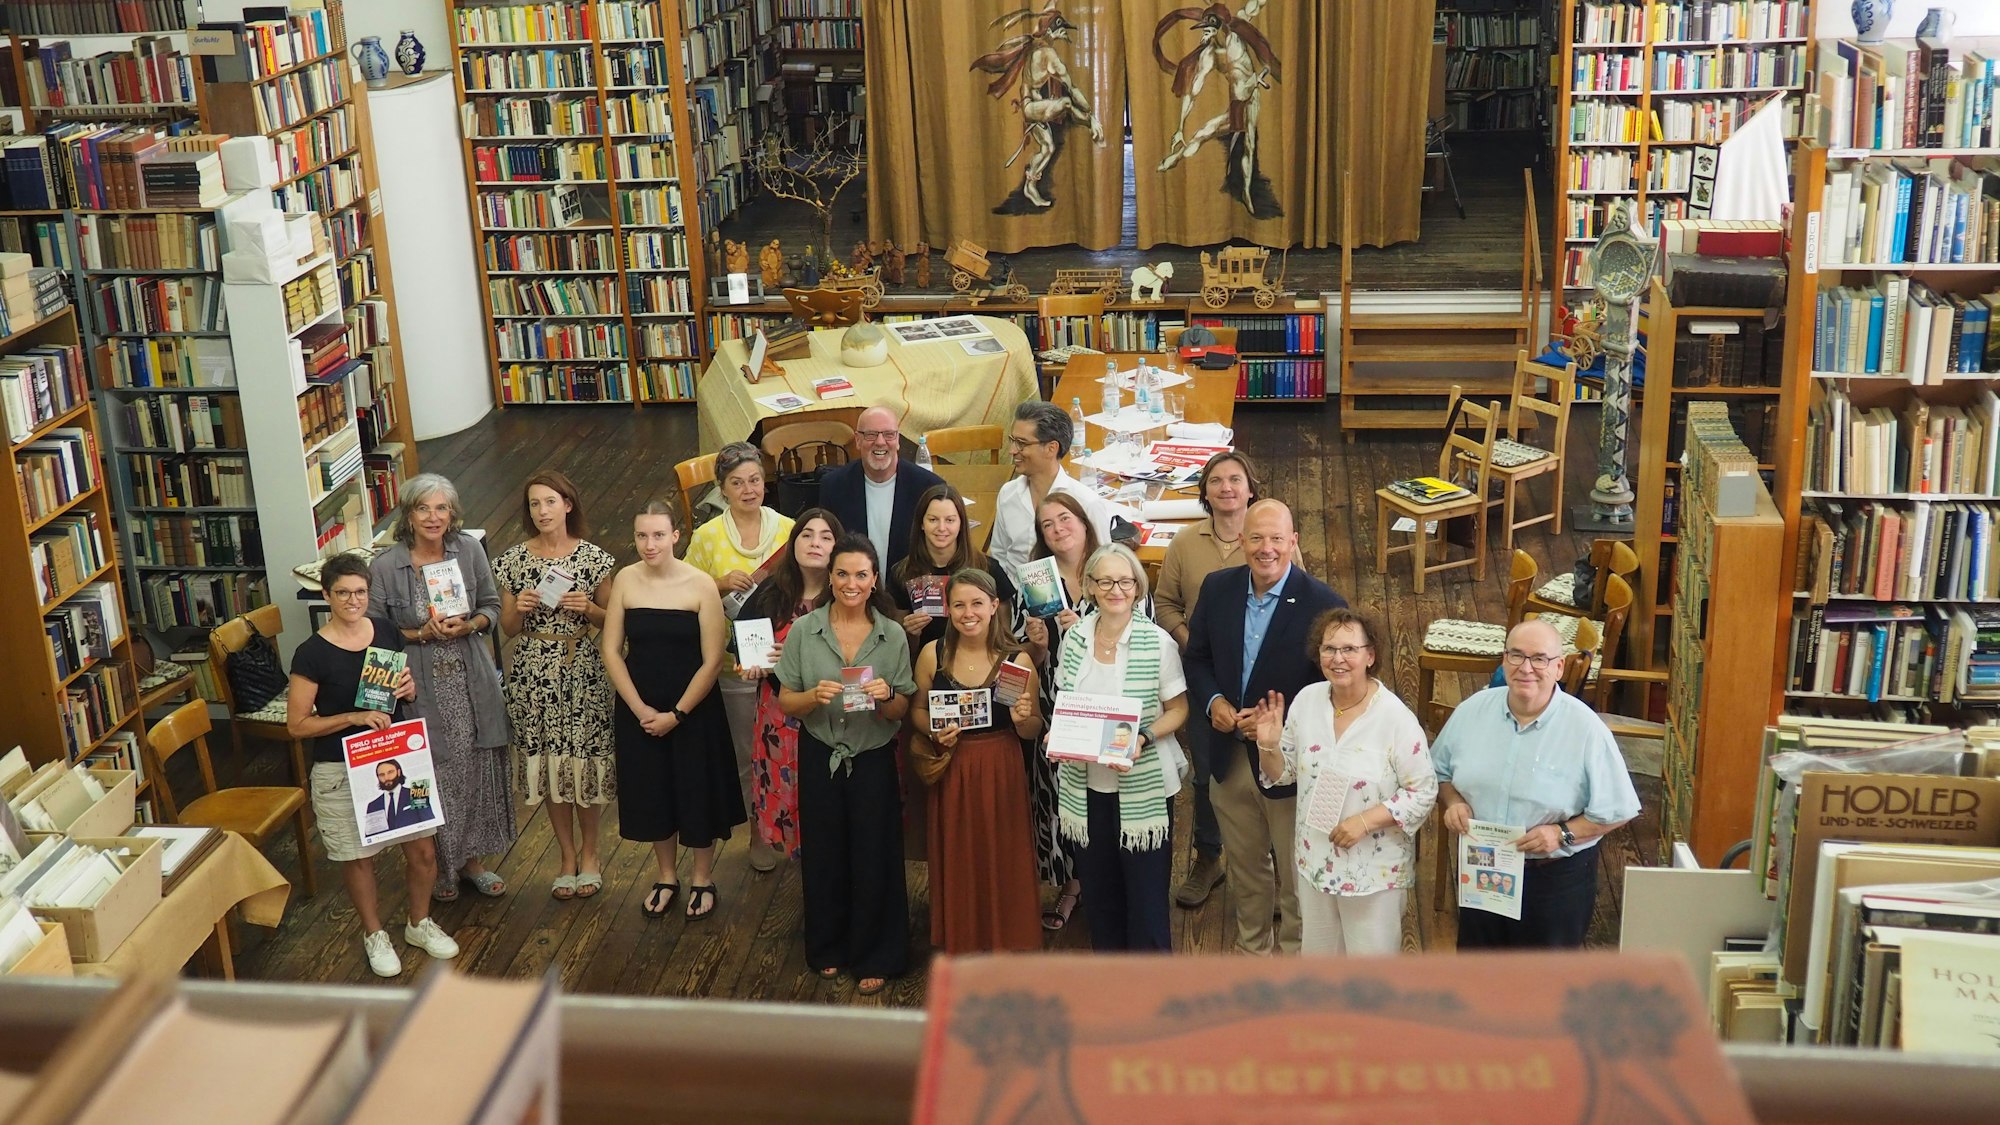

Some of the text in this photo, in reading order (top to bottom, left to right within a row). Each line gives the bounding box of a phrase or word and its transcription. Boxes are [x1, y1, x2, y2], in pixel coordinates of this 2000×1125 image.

[1808, 216, 1816, 270] EUROPA
[1888, 295, 1897, 325] IMAGO
[1028, 568, 1050, 579] MACHT
[361, 664, 401, 688] PIRLO
[1062, 702, 1120, 712] Kriminalgeschichten
[350, 730, 406, 750] PIRLO und Mahler
[1822, 784, 1981, 817] HODLER
[1820, 816, 1978, 831] UND DIE SCHWEIZER
[1108, 1053, 1554, 1098] Kinderfreund
